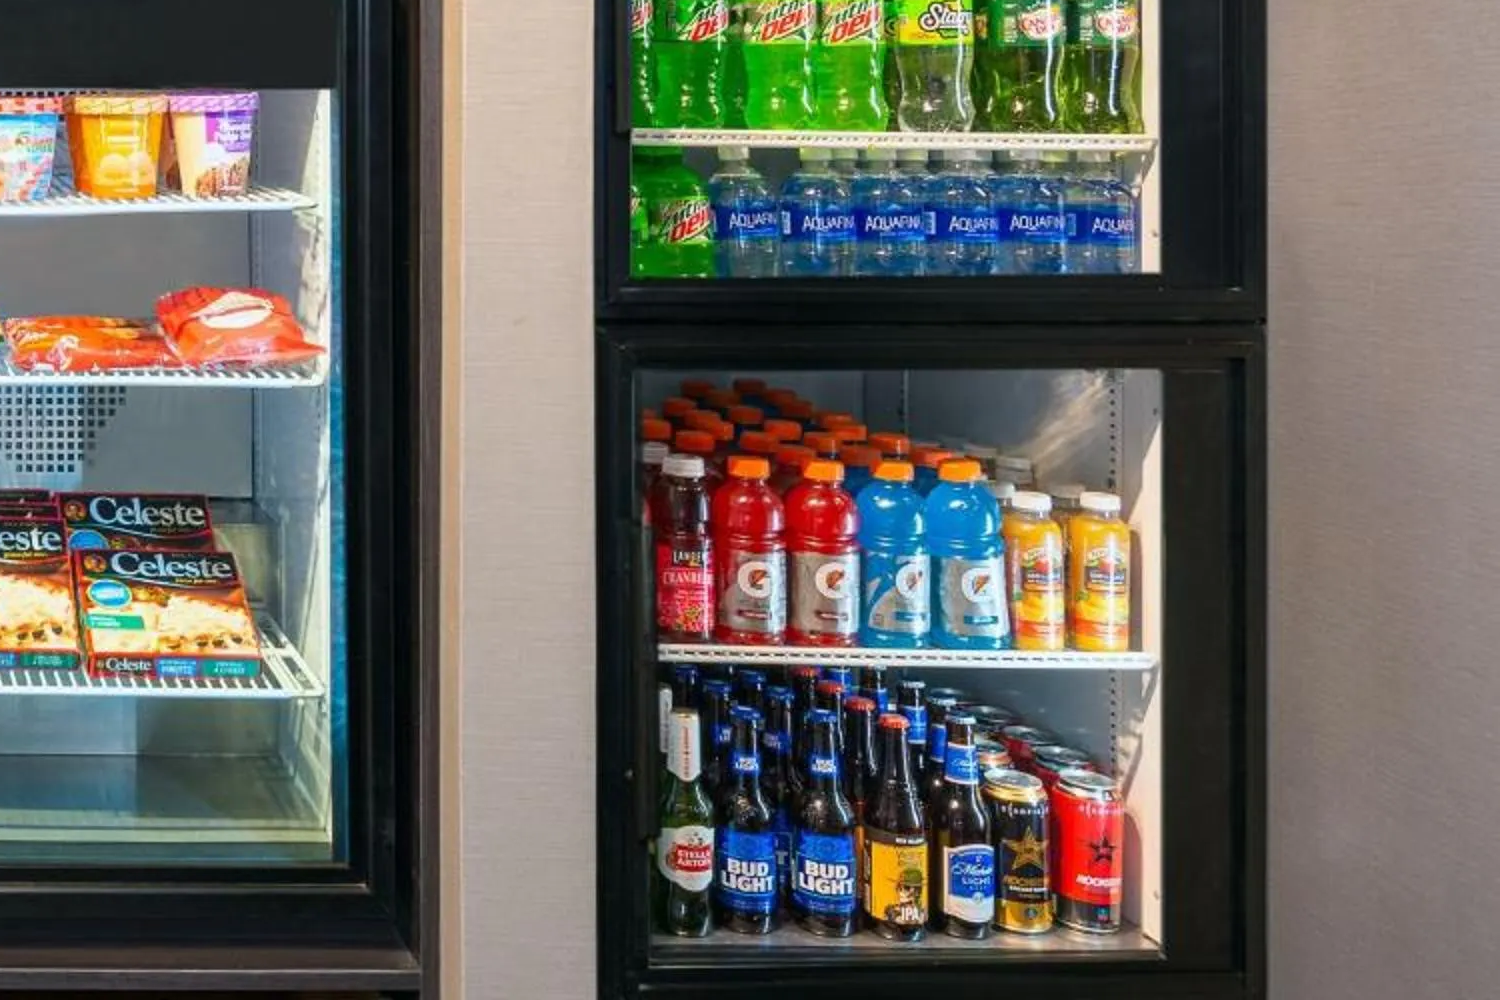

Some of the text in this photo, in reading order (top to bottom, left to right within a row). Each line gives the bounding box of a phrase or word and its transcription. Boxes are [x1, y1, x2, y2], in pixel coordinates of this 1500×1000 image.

[729, 211, 776, 229] AQUAFIN
[802, 215, 855, 232] AQUAFIN
[948, 216, 999, 232] AQUAFIN
[1010, 214, 1065, 231] AQUAFIN
[89, 496, 206, 527] Celeste
[110, 551, 233, 578] Celeste
[105, 657, 152, 672] Celeste
[677, 859, 711, 868] ARTOI
[726, 857, 769, 877] BUD
[805, 859, 849, 880] BUD
[720, 871, 773, 893] LIGHT
[799, 871, 854, 895] LIGHT
[901, 905, 919, 921] IPA
